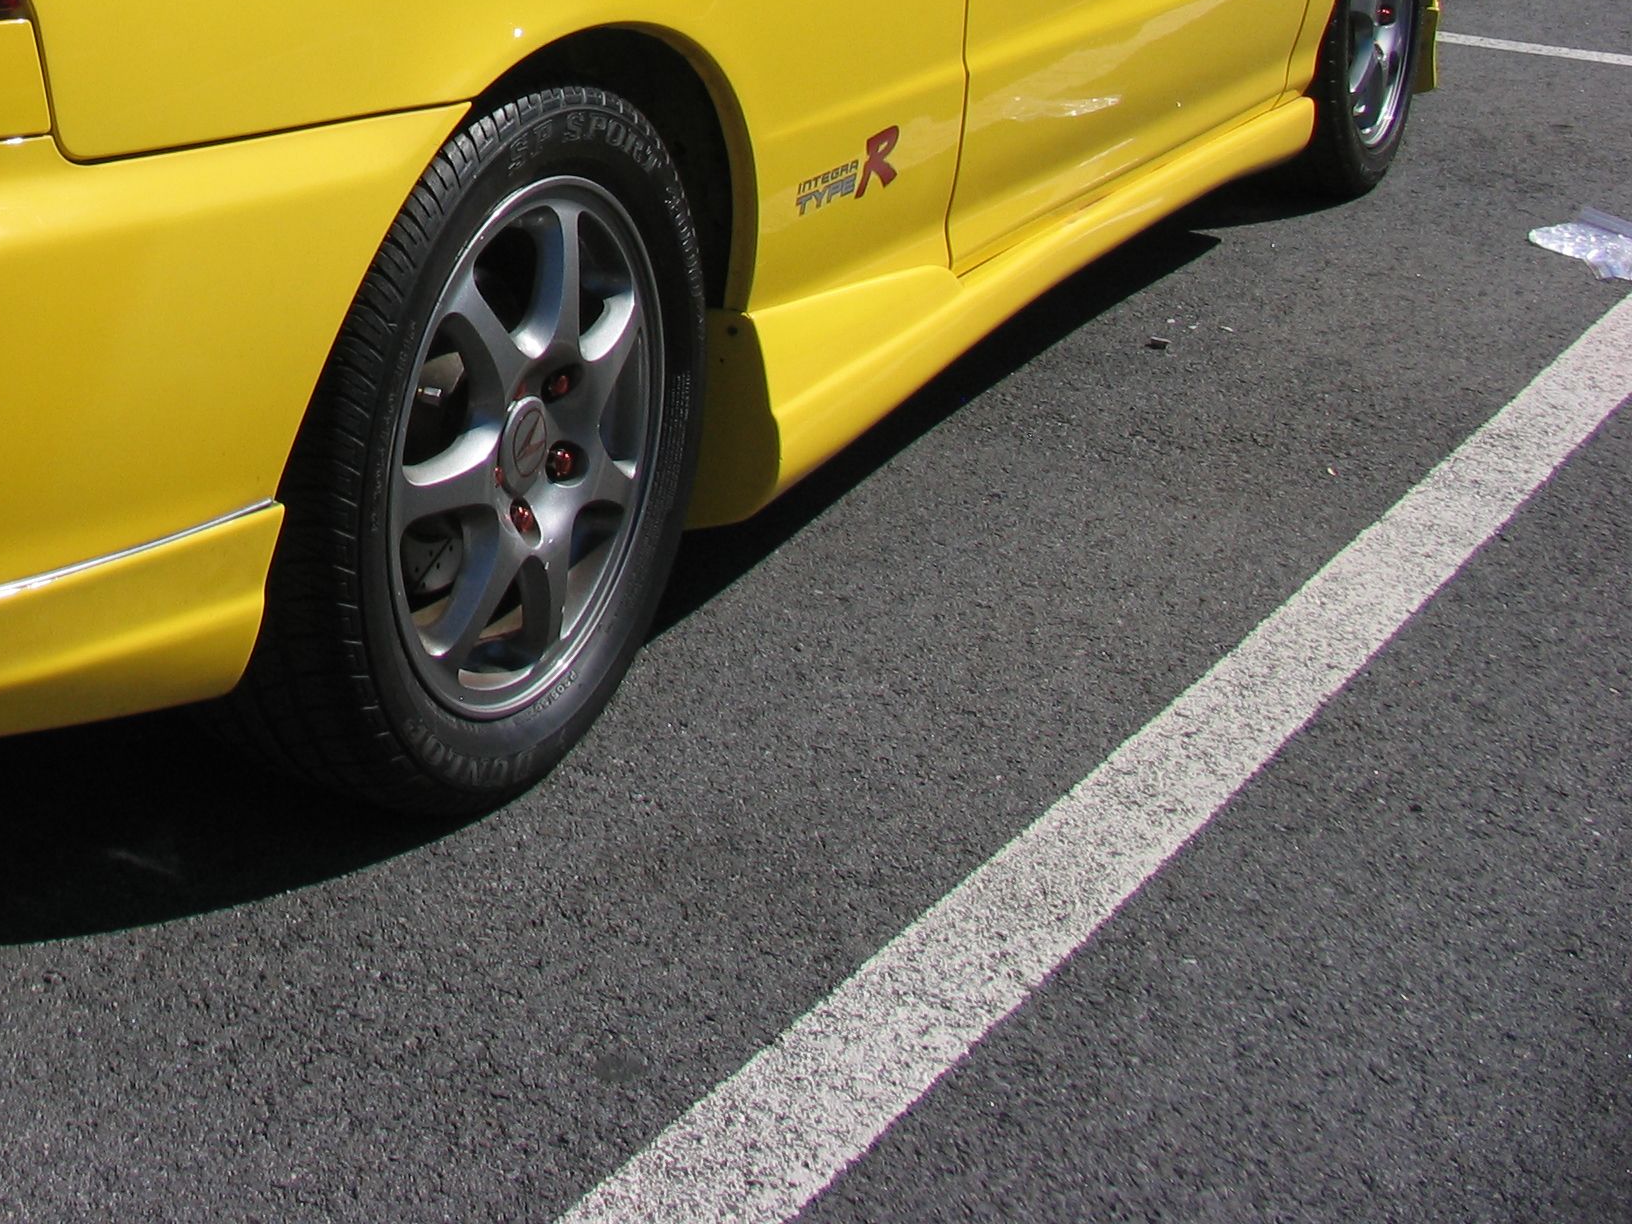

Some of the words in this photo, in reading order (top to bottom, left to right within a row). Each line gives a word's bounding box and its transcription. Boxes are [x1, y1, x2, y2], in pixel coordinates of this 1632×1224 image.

[795, 172, 857, 217] TYPE
[854, 124, 900, 200] R
[797, 159, 859, 195] INTEGRA
